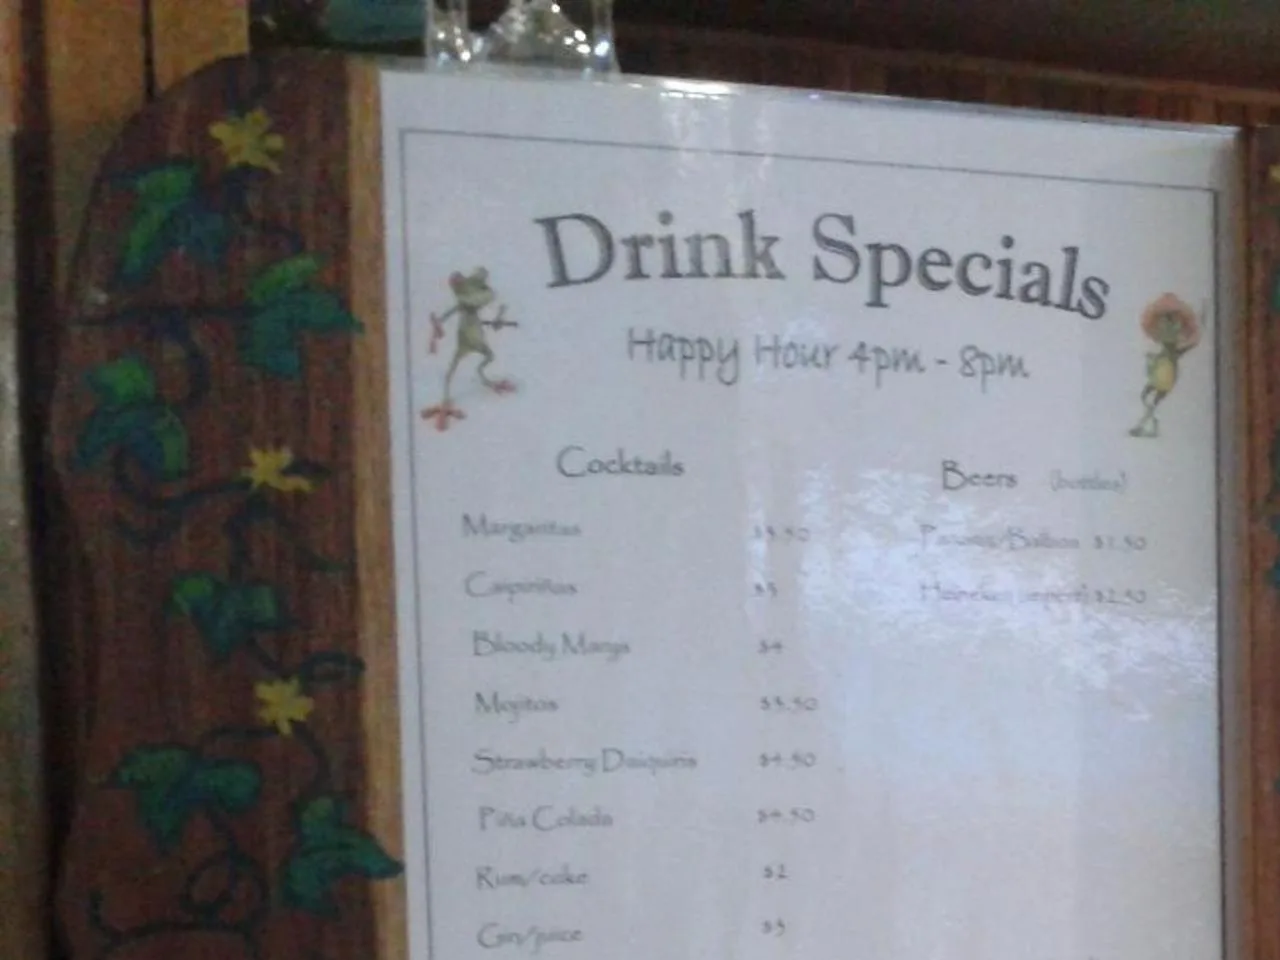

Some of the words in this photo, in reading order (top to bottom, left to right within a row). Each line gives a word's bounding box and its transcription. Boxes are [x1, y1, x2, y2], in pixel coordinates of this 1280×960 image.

[534, 209, 786, 289] Drink
[811, 213, 1111, 320] Specials
[627, 327, 739, 386] Happy
[754, 332, 841, 370] Hour
[848, 340, 926, 389] 4pm
[958, 344, 1031, 393] 8pm
[557, 446, 685, 478] Cocktails
[942, 459, 1018, 490] Beers
[473, 630, 557, 662] Bloody
